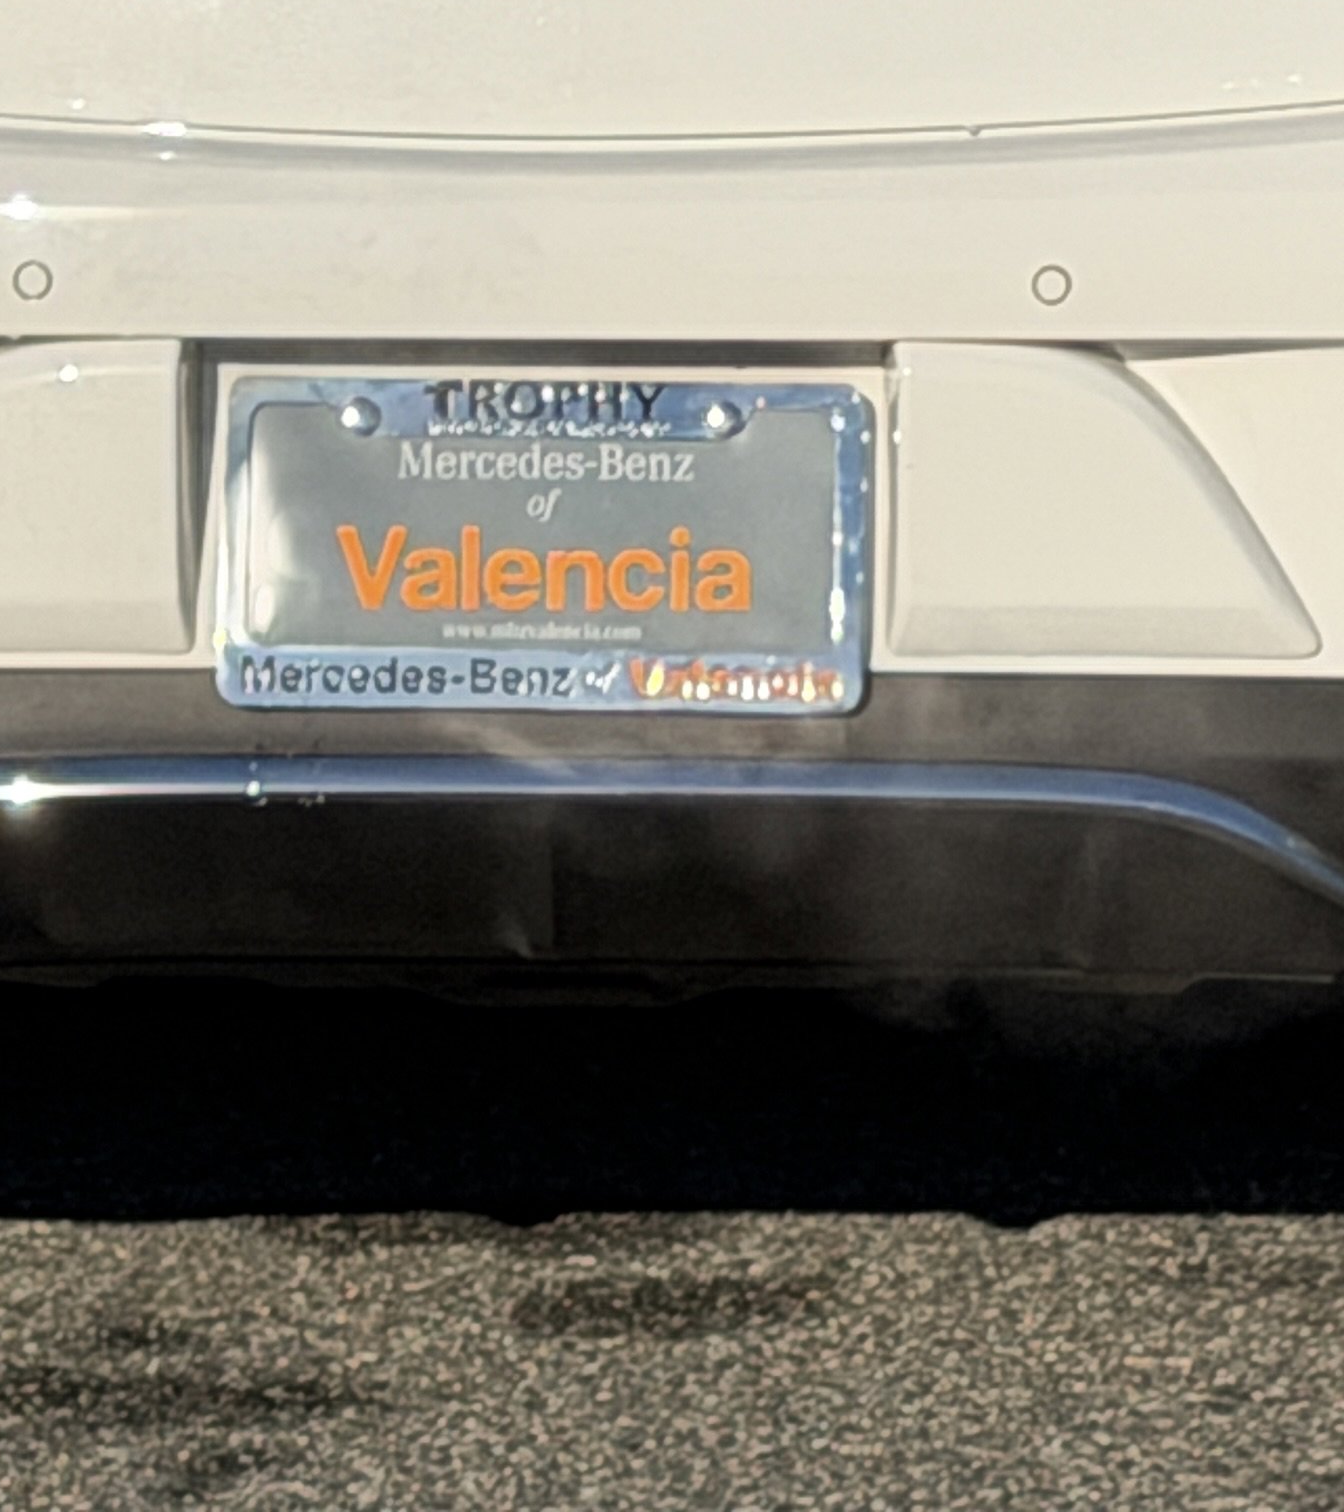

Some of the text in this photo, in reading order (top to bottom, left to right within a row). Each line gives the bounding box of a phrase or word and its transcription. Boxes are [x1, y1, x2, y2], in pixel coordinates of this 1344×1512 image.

[422, 379, 669, 422] TROPHY
[396, 439, 697, 483] Mercedes-Benz
[525, 488, 562, 524] of
[335, 524, 752, 612] Valencia
[240, 655, 578, 698] Mercedes-Benz
